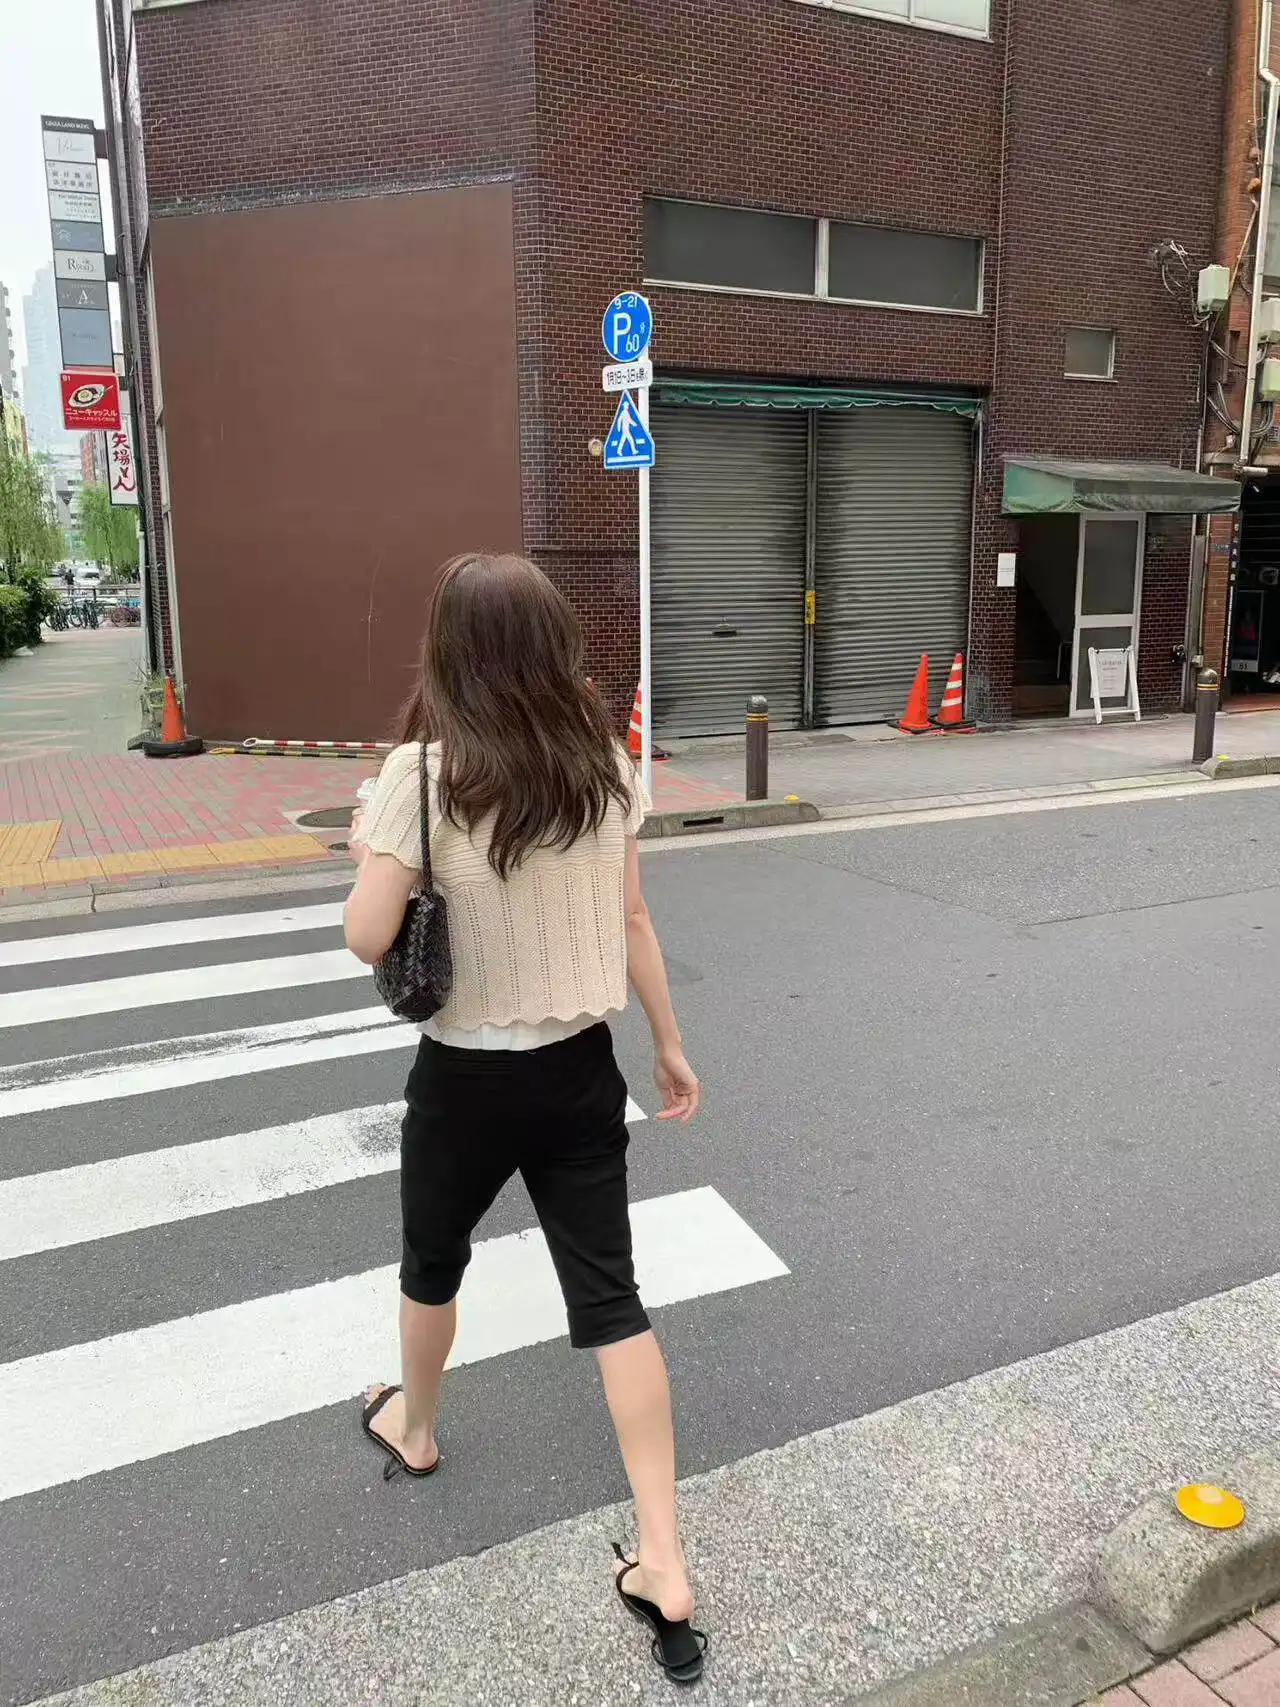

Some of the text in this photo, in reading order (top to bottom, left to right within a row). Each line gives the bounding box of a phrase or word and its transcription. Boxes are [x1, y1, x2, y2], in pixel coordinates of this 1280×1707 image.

[614, 296, 638, 309] 9-21
[613, 312, 632, 355] P
[625, 333, 640, 353] 60
[64, 407, 118, 418] ニューキャッスル
[112, 432, 136, 492] 矢場とん
